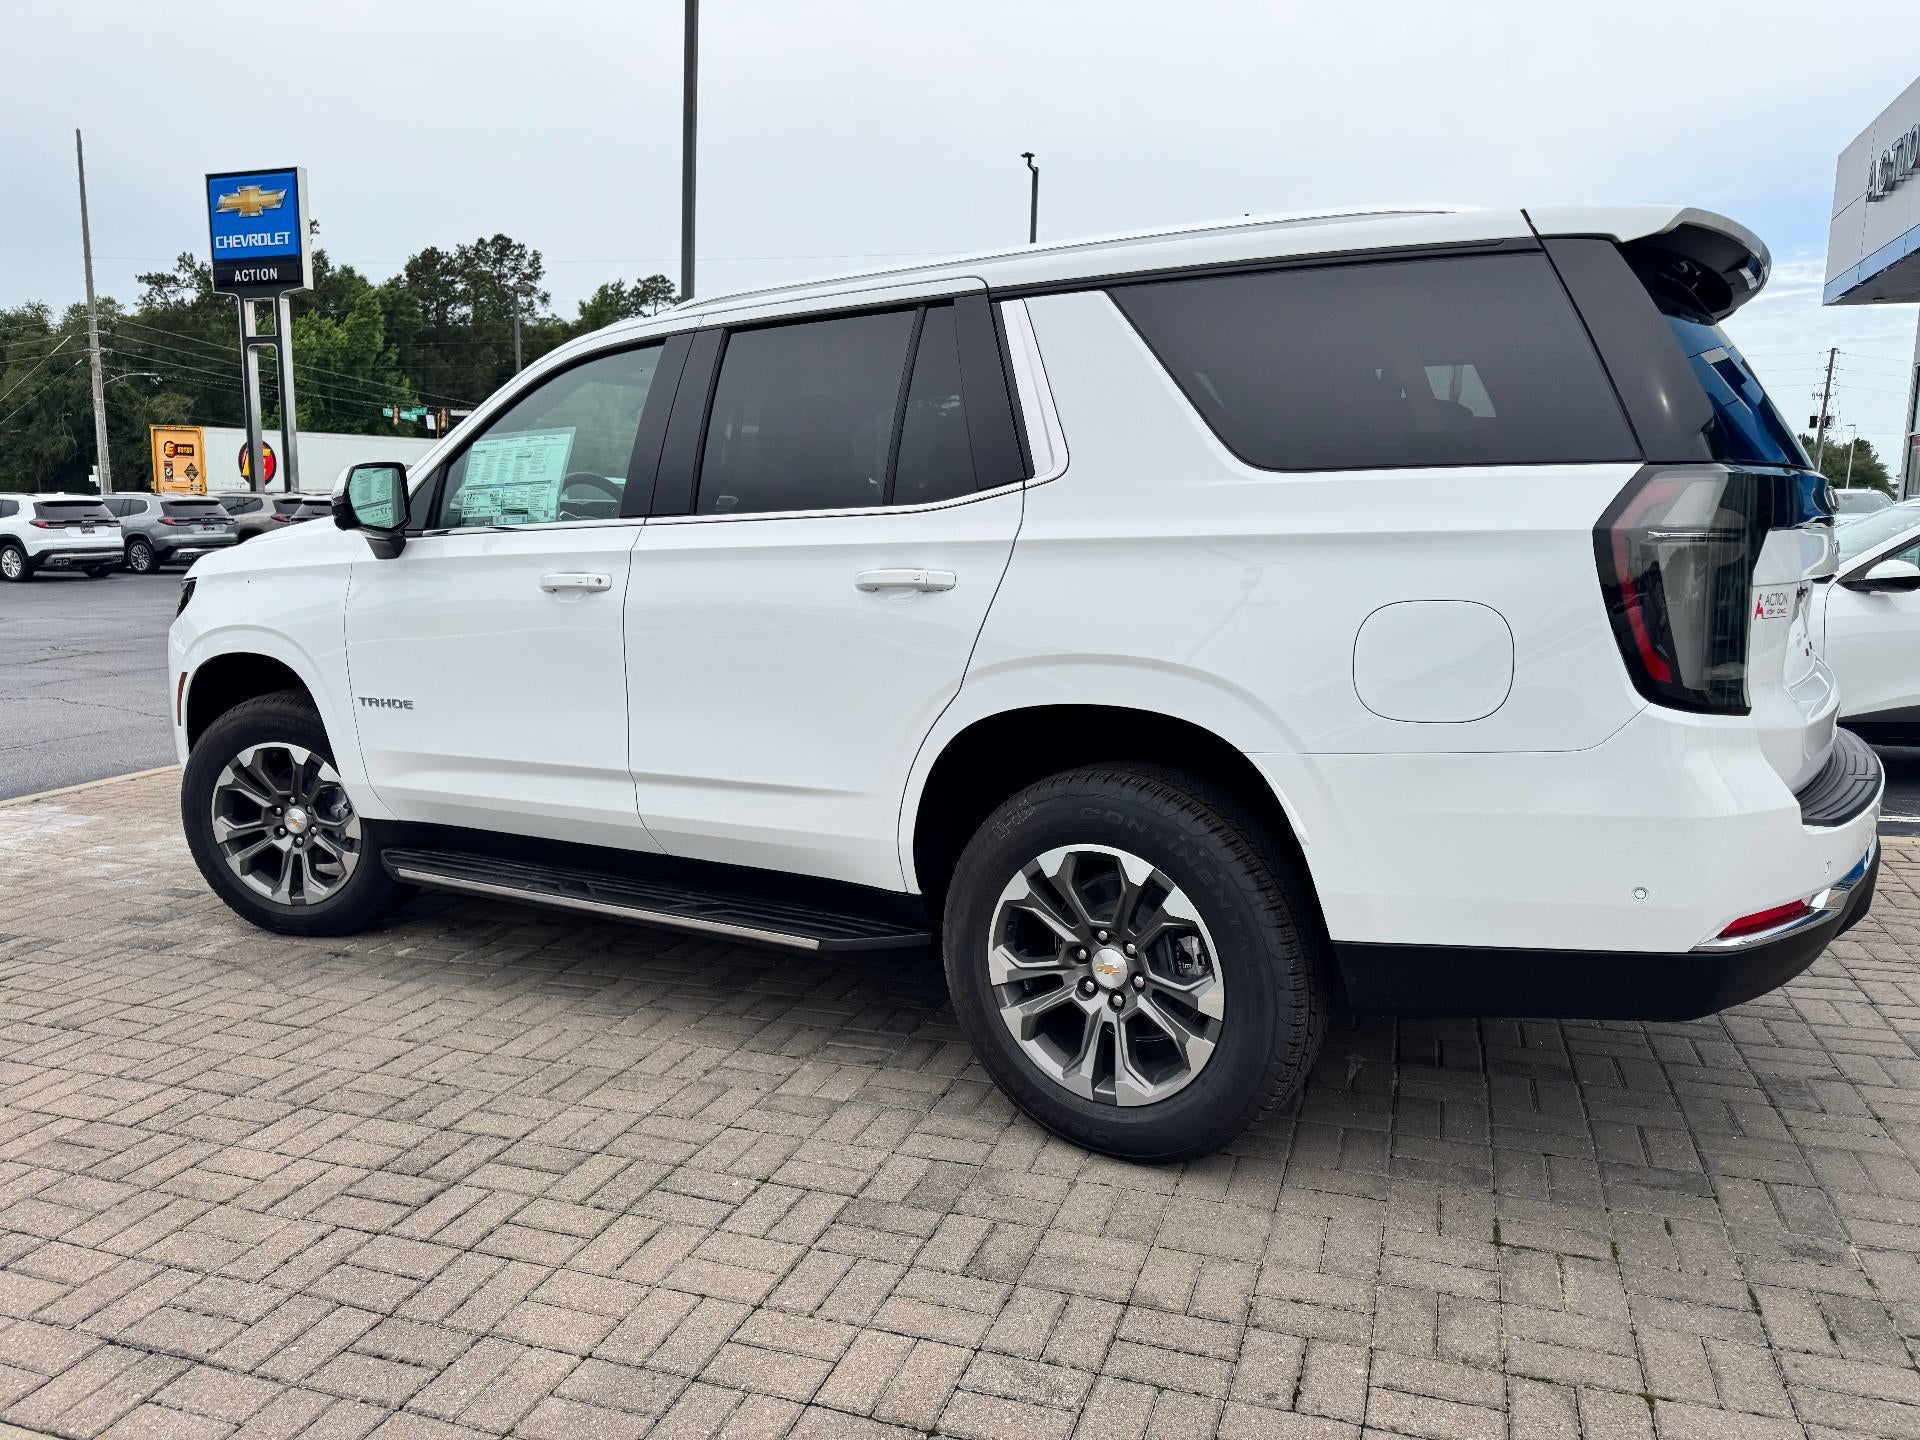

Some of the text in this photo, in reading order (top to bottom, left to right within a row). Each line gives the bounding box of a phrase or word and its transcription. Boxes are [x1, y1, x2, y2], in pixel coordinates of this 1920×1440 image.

[215, 231, 291, 249] CHEVROLET
[234, 267, 278, 282] ACTION
[1765, 592, 1789, 606] ACTION
[358, 696, 415, 710] TAHOE
